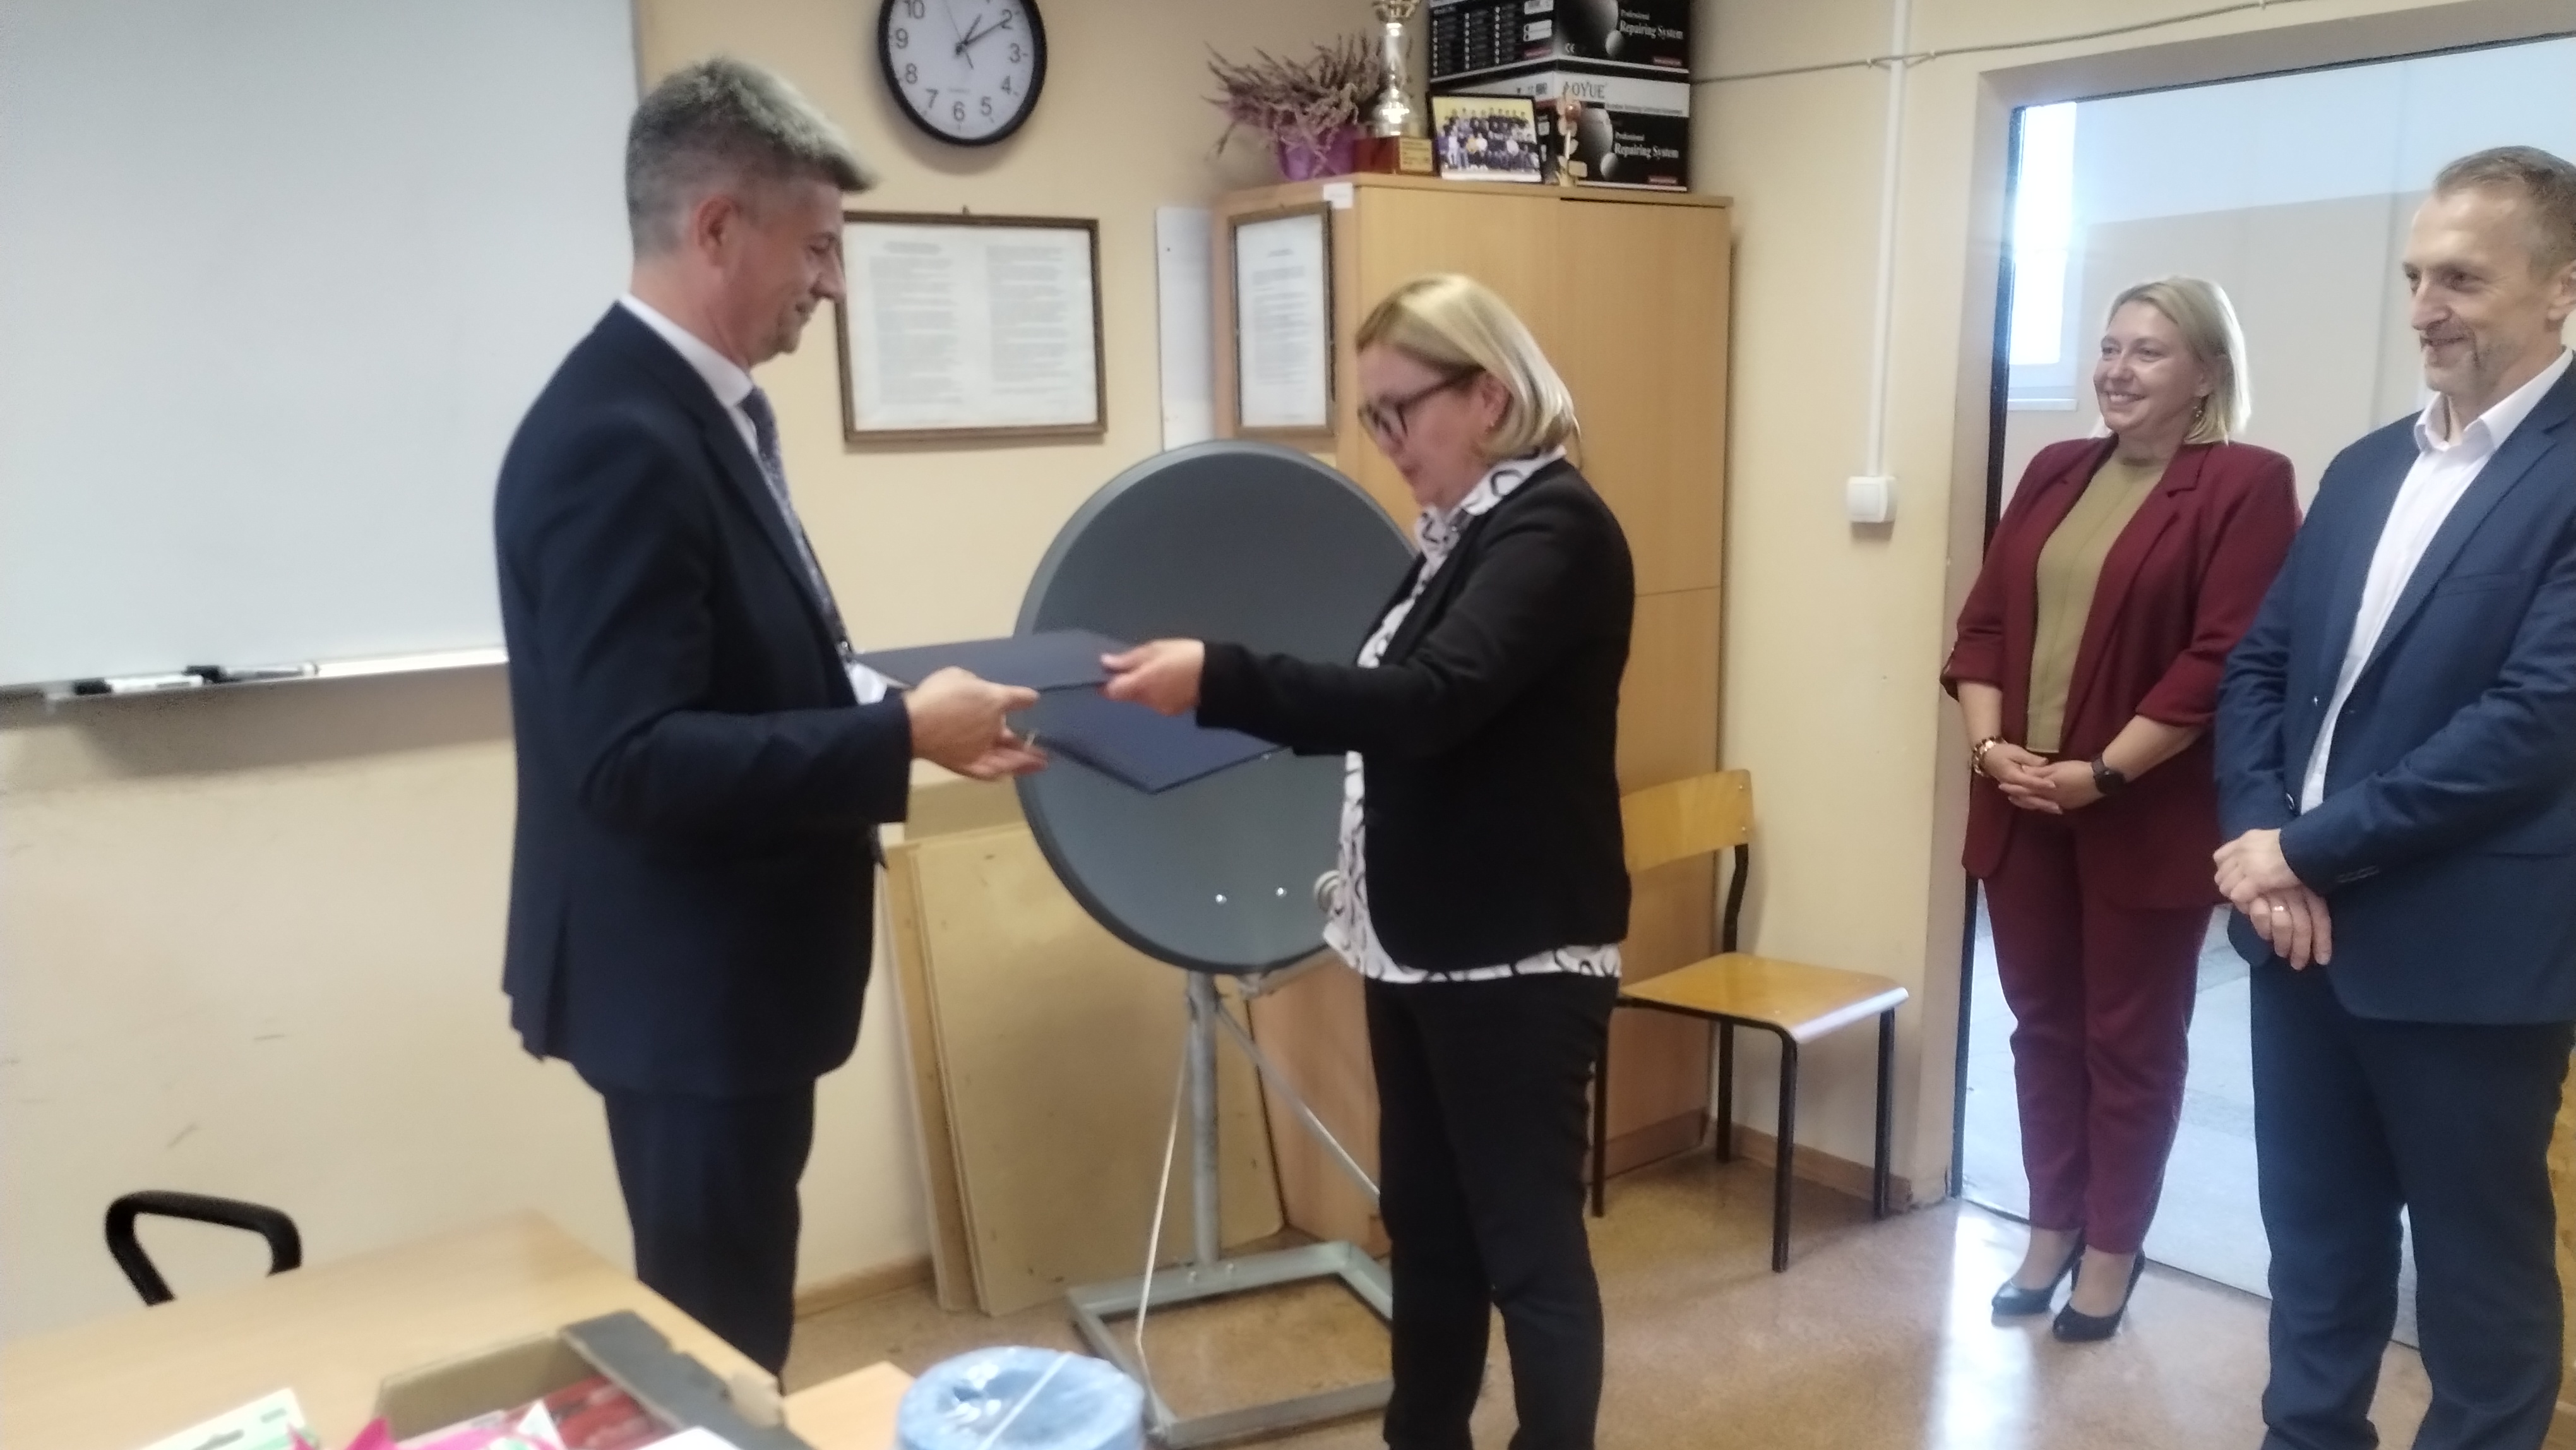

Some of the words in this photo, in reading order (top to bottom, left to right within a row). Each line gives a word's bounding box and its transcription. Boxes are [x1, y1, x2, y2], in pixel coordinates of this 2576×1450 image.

[904, 0, 924, 19] 10
[1001, 9, 1013, 30] 2
[895, 28, 909, 49] 9
[1620, 20, 1657, 39] Repairing
[1657, 25, 1683, 40] System
[1009, 43, 1021, 63] 3
[905, 63, 917, 84] 8
[1001, 75, 1011, 95] 4
[926, 88, 939, 109] 7
[981, 96, 992, 116] 5
[952, 101, 965, 121] 6
[1614, 142, 1652, 160] Repairing
[1652, 145, 1679, 160] System
